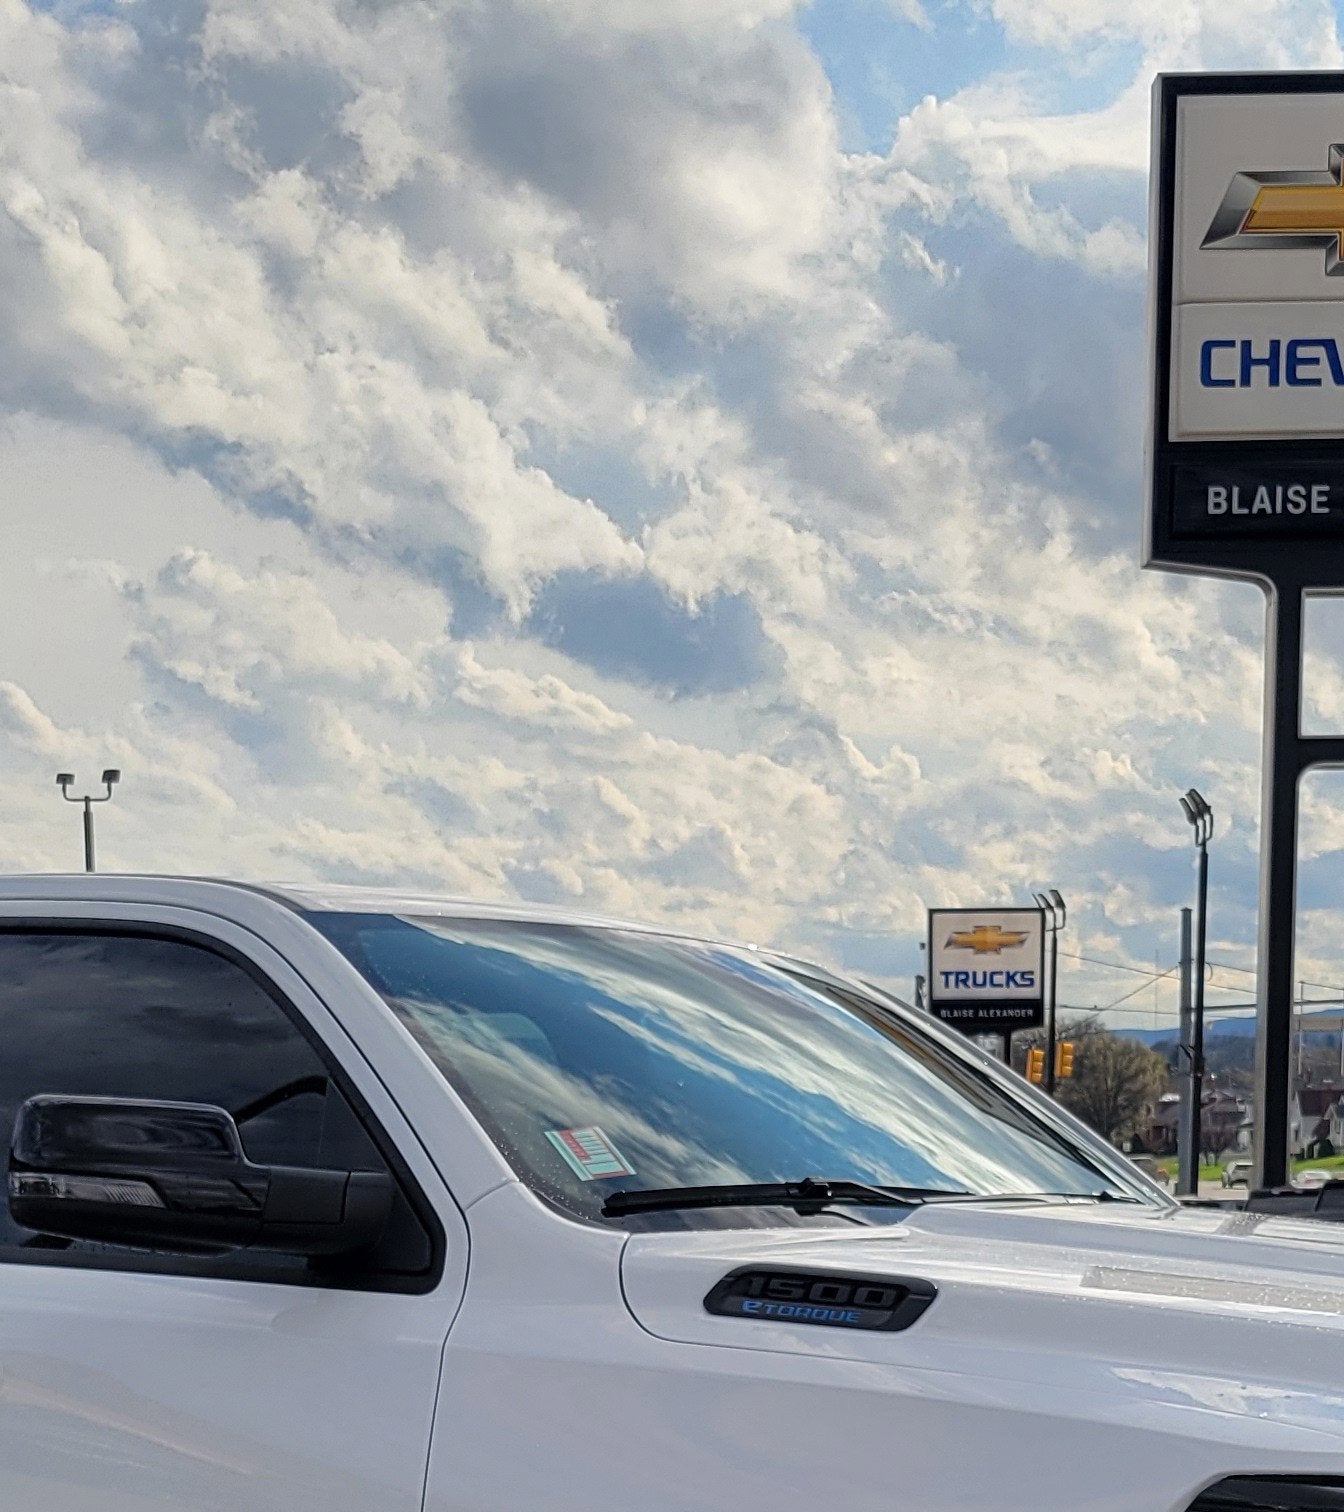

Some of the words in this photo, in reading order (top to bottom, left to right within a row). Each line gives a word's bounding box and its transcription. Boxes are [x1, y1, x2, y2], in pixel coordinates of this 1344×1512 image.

[1207, 484, 1331, 515] BLAISE
[940, 970, 1035, 989] TRUCKS
[940, 1009, 974, 1018] BLAISE
[978, 1009, 1034, 1018] ALEXANDER
[746, 1275, 898, 1310] 1500
